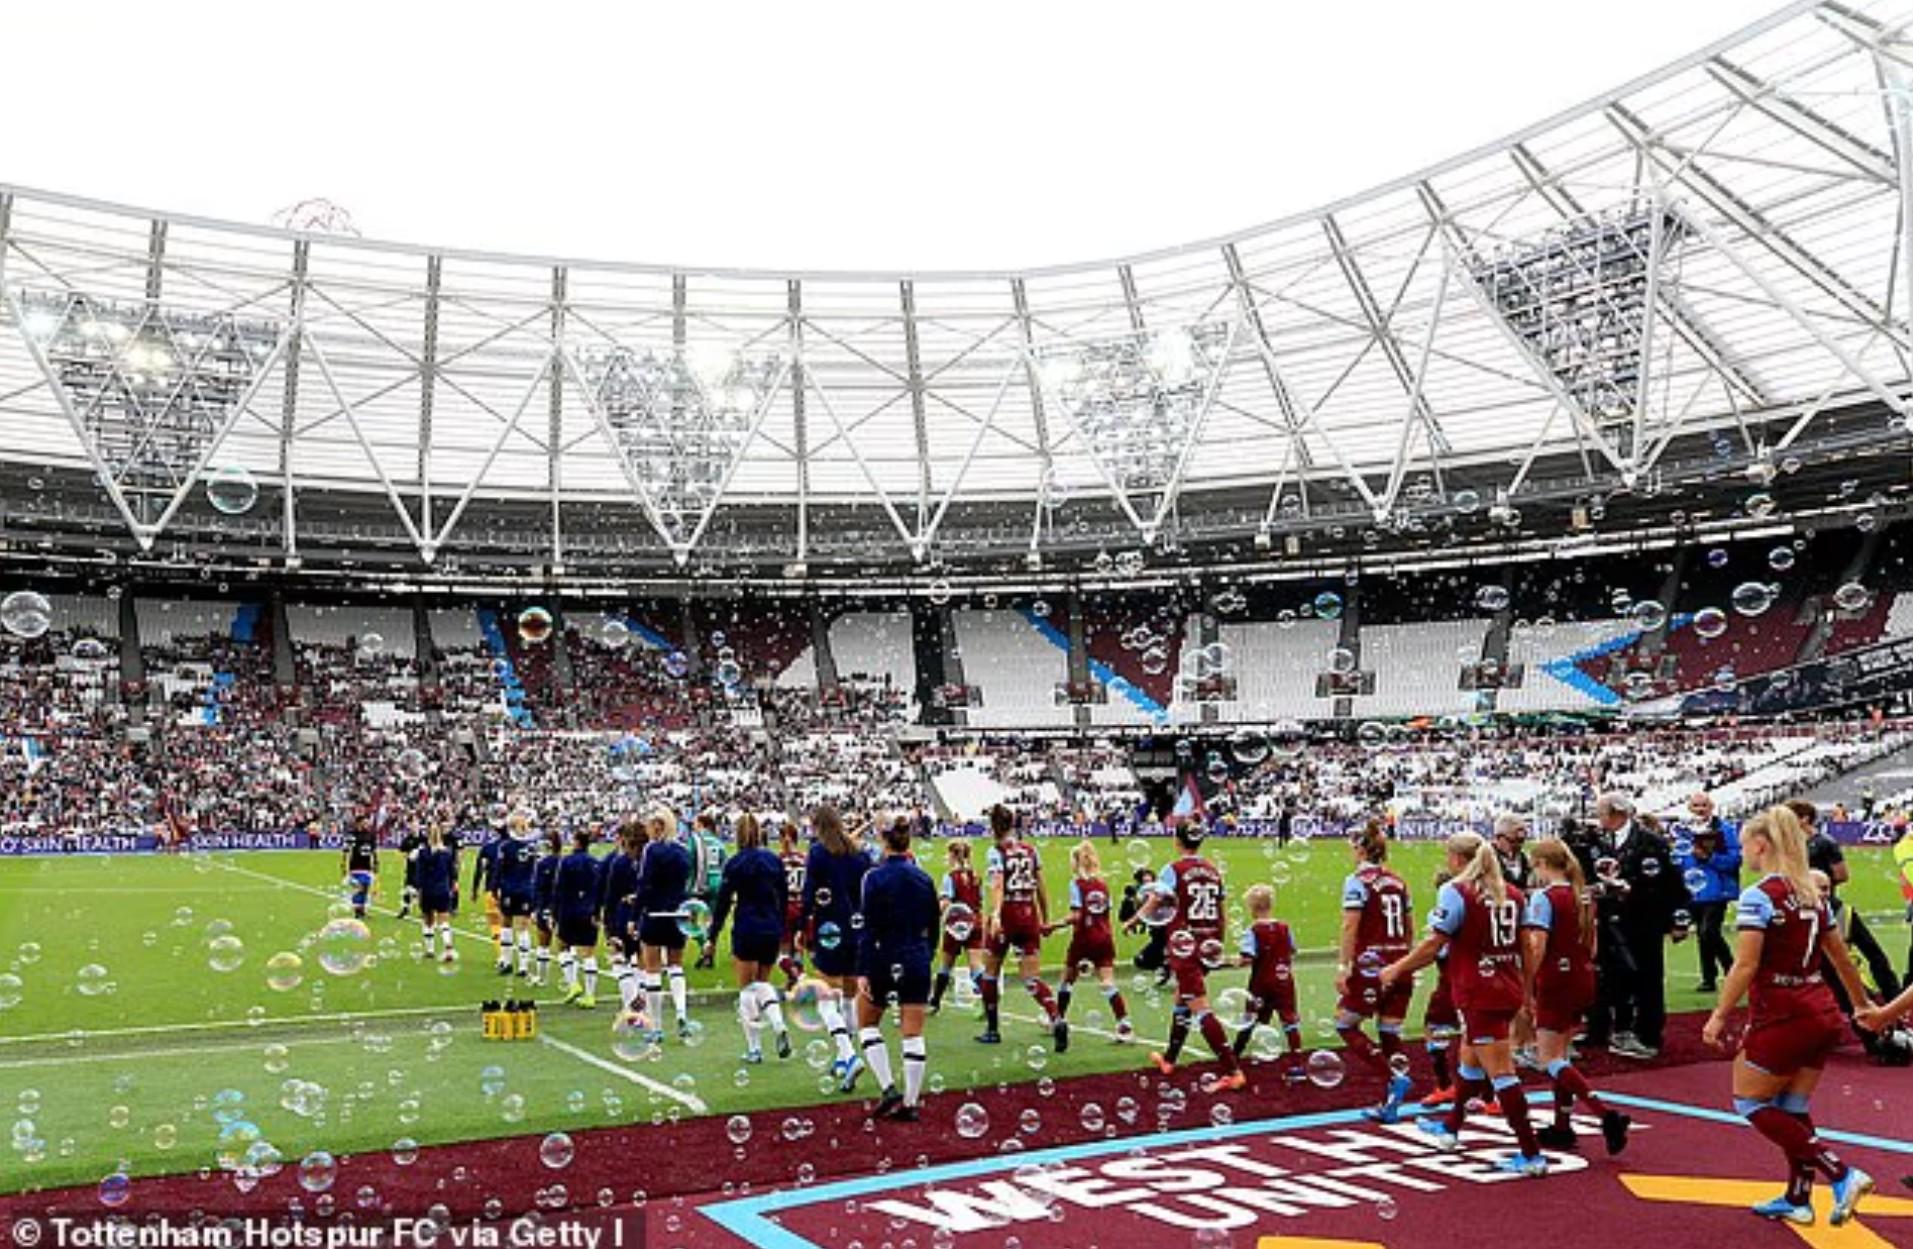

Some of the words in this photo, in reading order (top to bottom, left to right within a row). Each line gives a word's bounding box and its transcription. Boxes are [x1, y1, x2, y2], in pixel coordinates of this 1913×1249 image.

[21, 837, 63, 850] SKIN
[191, 835, 229, 848] SKIN
[231, 834, 296, 848] HEALTH
[1187, 882, 1220, 920] 26
[1380, 893, 1404, 938] 11
[1484, 898, 1517, 947] 19
[1799, 910, 1819, 968] 7
[868, 1146, 1292, 1232] WEST
[1124, 1148, 1589, 1230] UNITED
